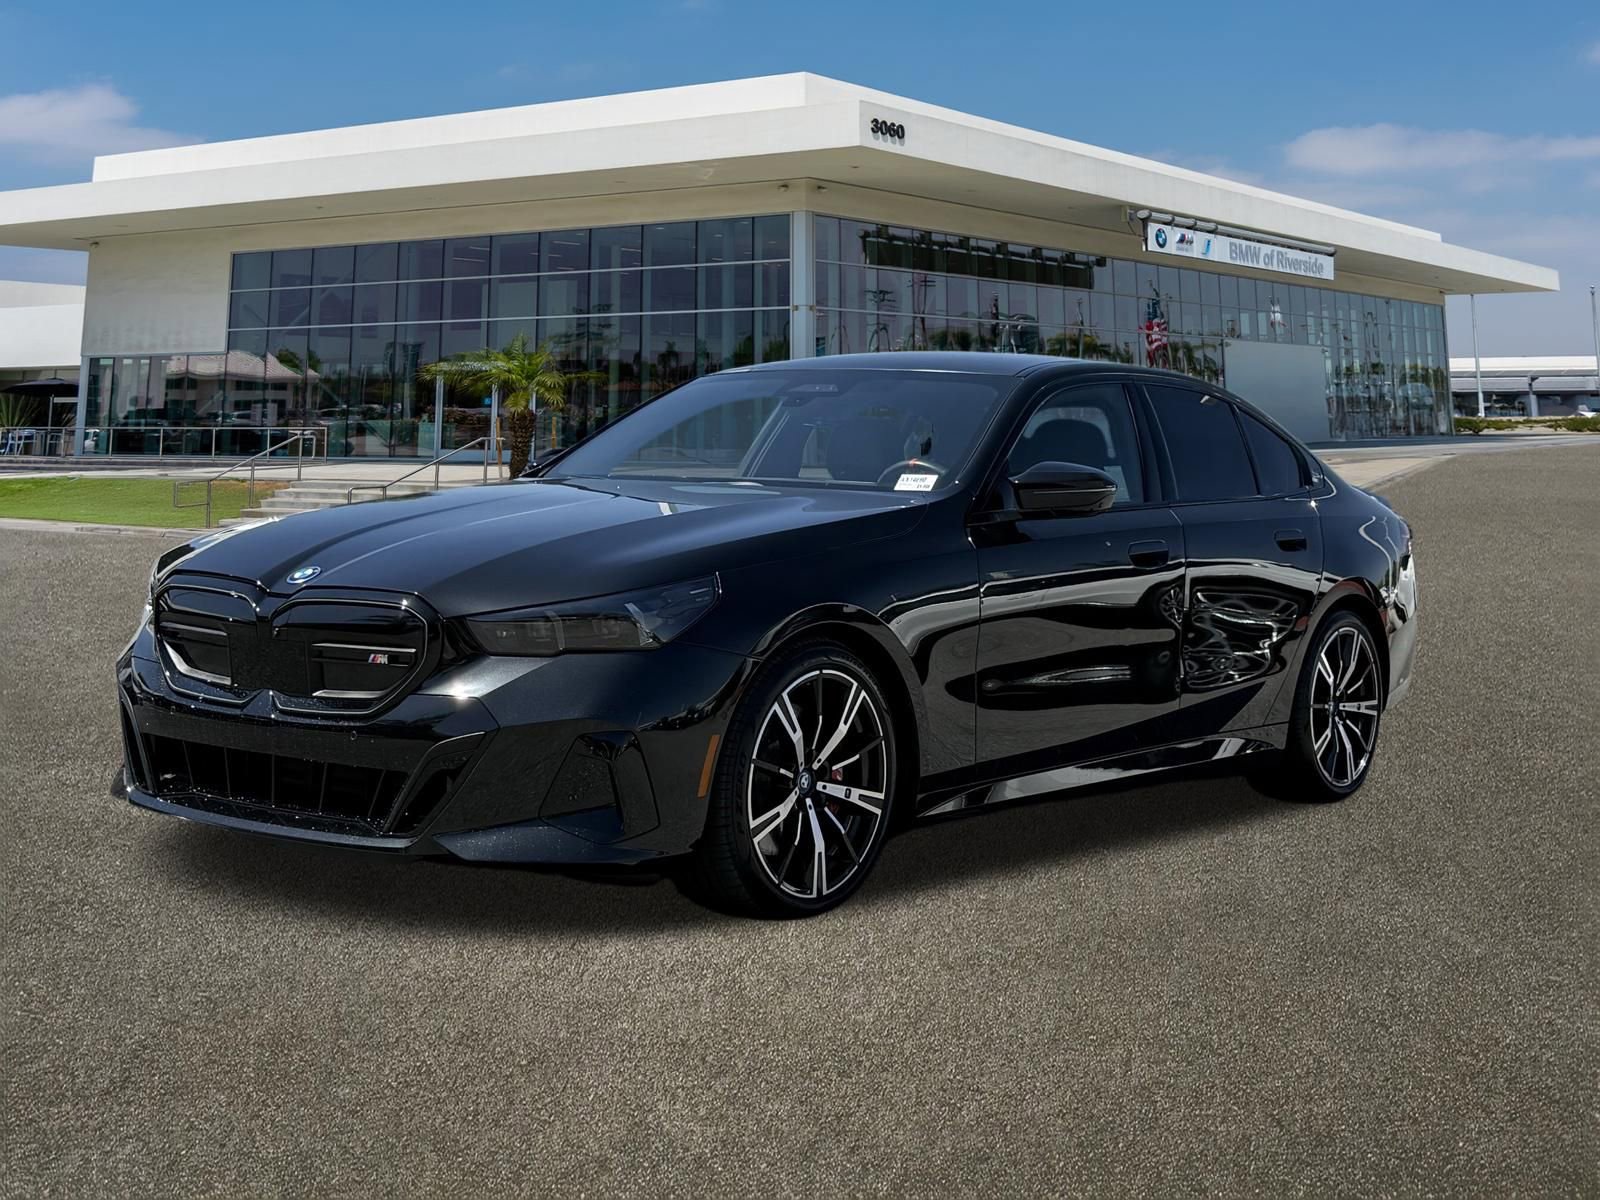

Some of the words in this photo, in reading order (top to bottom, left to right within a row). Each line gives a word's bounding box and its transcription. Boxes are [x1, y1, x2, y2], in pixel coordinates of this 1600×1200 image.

[870, 118, 905, 139] 3060
[1229, 241, 1261, 265] BMW
[1263, 249, 1275, 267] of
[1276, 250, 1324, 275] Riverside
